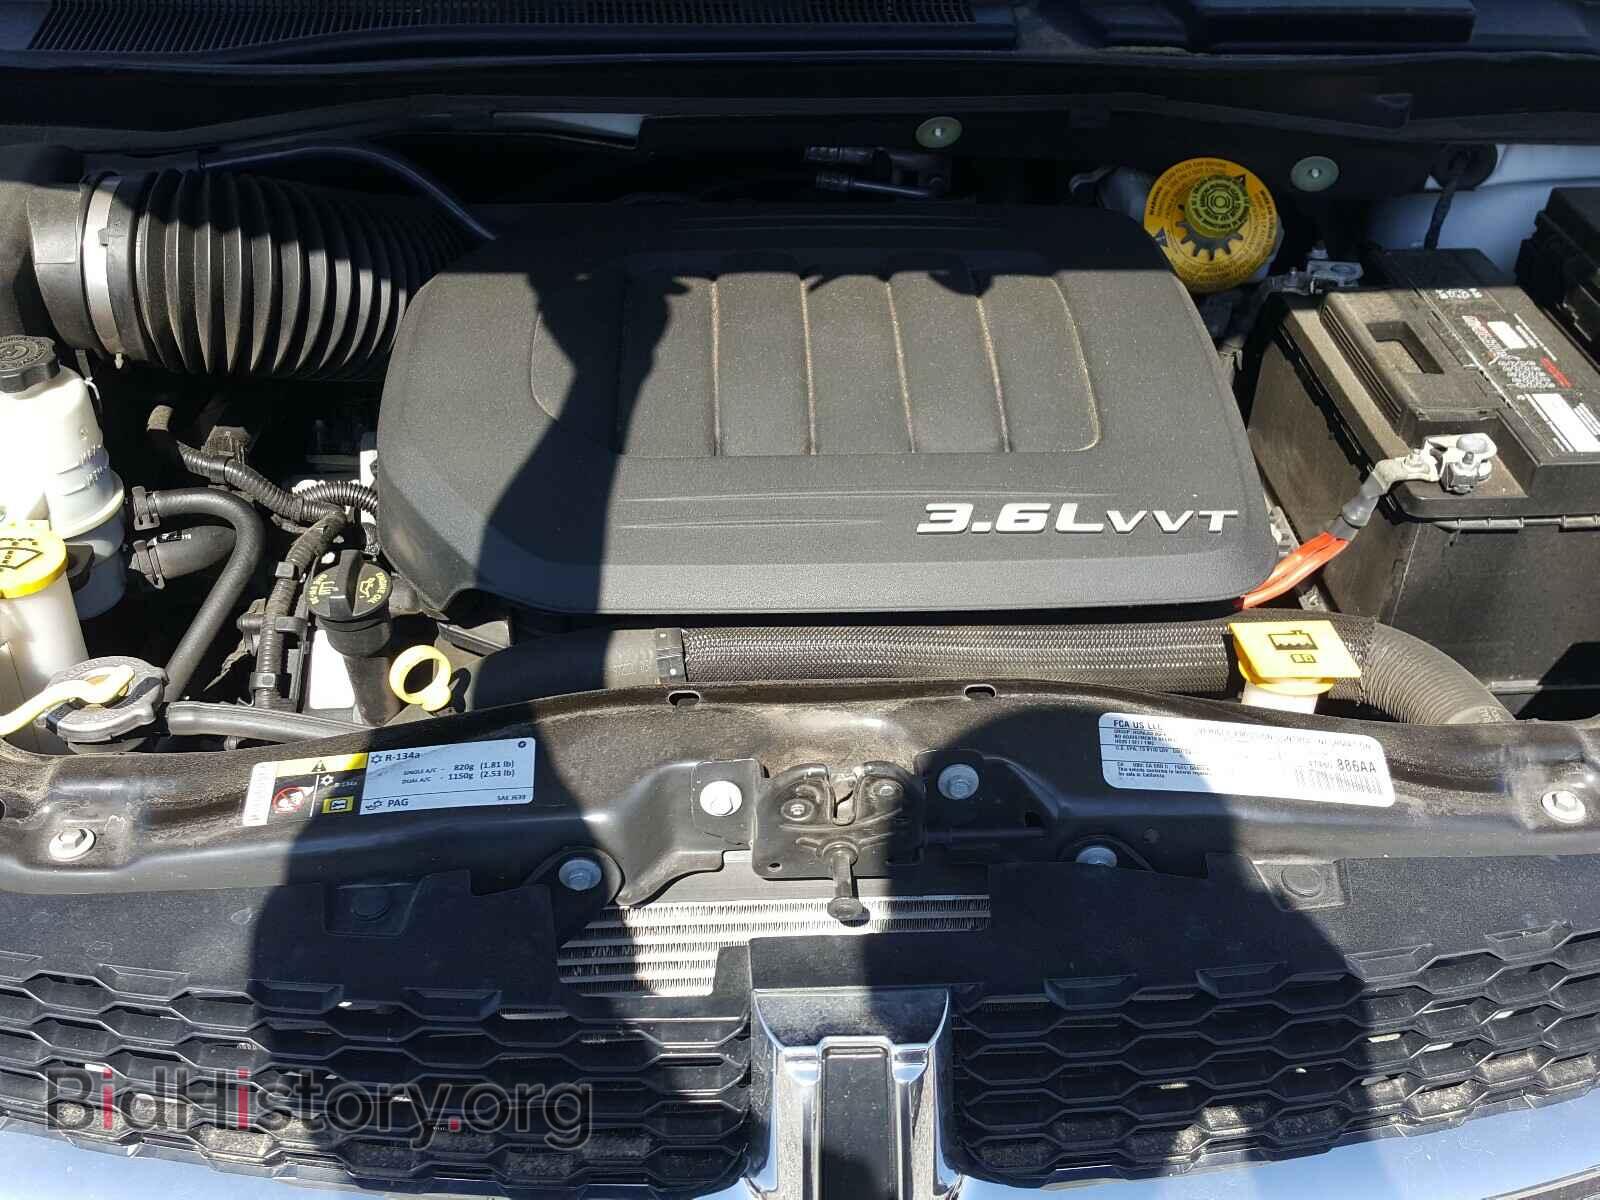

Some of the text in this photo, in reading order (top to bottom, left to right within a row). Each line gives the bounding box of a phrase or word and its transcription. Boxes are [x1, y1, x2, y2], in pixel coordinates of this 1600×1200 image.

[1113, 719, 1130, 729] FCA
[1133, 720, 1145, 729] US
[384, 752, 421, 763] R-134a
[453, 763, 475, 774] 820g
[480, 759, 501, 771] (1.81
[502, 758, 515, 769] lb)
[1337, 758, 1377, 774] 886AA
[448, 771, 475, 783] 1150g
[480, 769, 501, 780] (2.53
[502, 768, 515, 779] lb)
[387, 798, 409, 809] PAG
